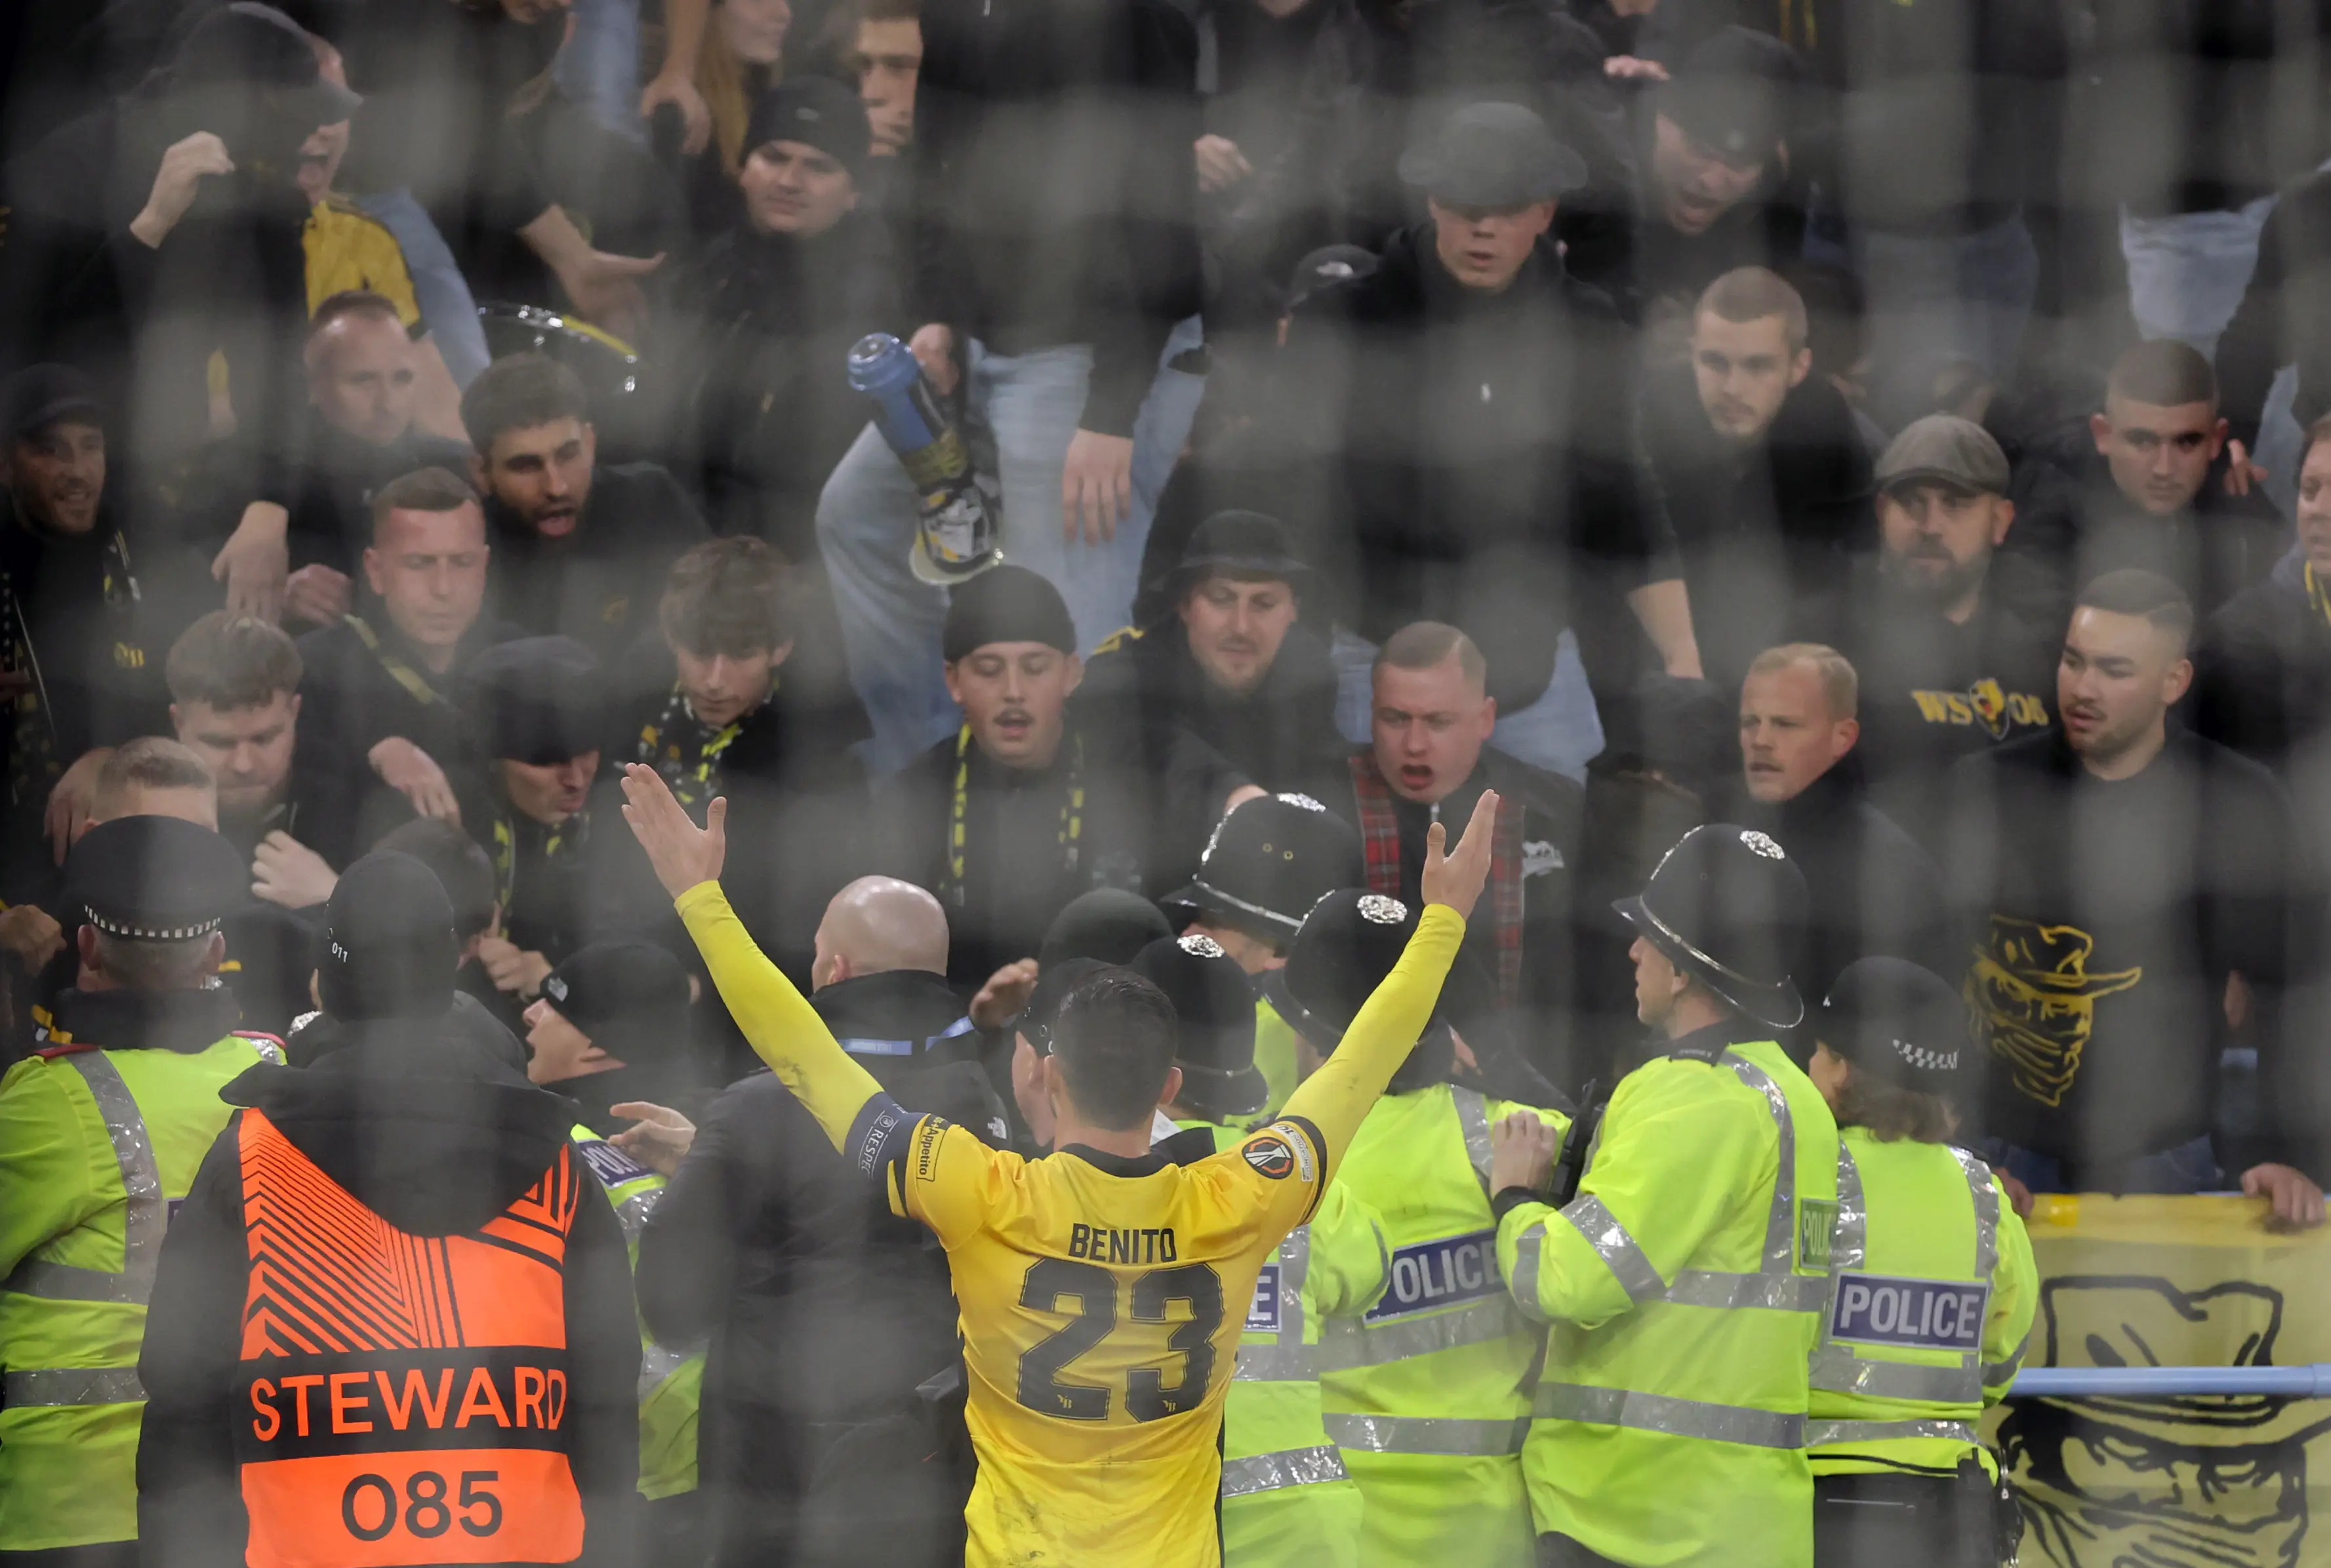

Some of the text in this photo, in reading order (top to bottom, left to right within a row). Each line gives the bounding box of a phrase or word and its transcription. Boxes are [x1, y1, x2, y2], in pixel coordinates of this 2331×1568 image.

[332, 942, 348, 963] 011
[861, 1128, 885, 1178] RESPEC
[1068, 1223, 1177, 1264] BENITO
[1393, 1240, 1502, 1304] OLICE
[1017, 1256, 1225, 1423] 23
[1840, 1283, 1980, 1338] POLICE
[251, 1367, 567, 1441] STEWARD
[342, 1470, 502, 1542] 085
